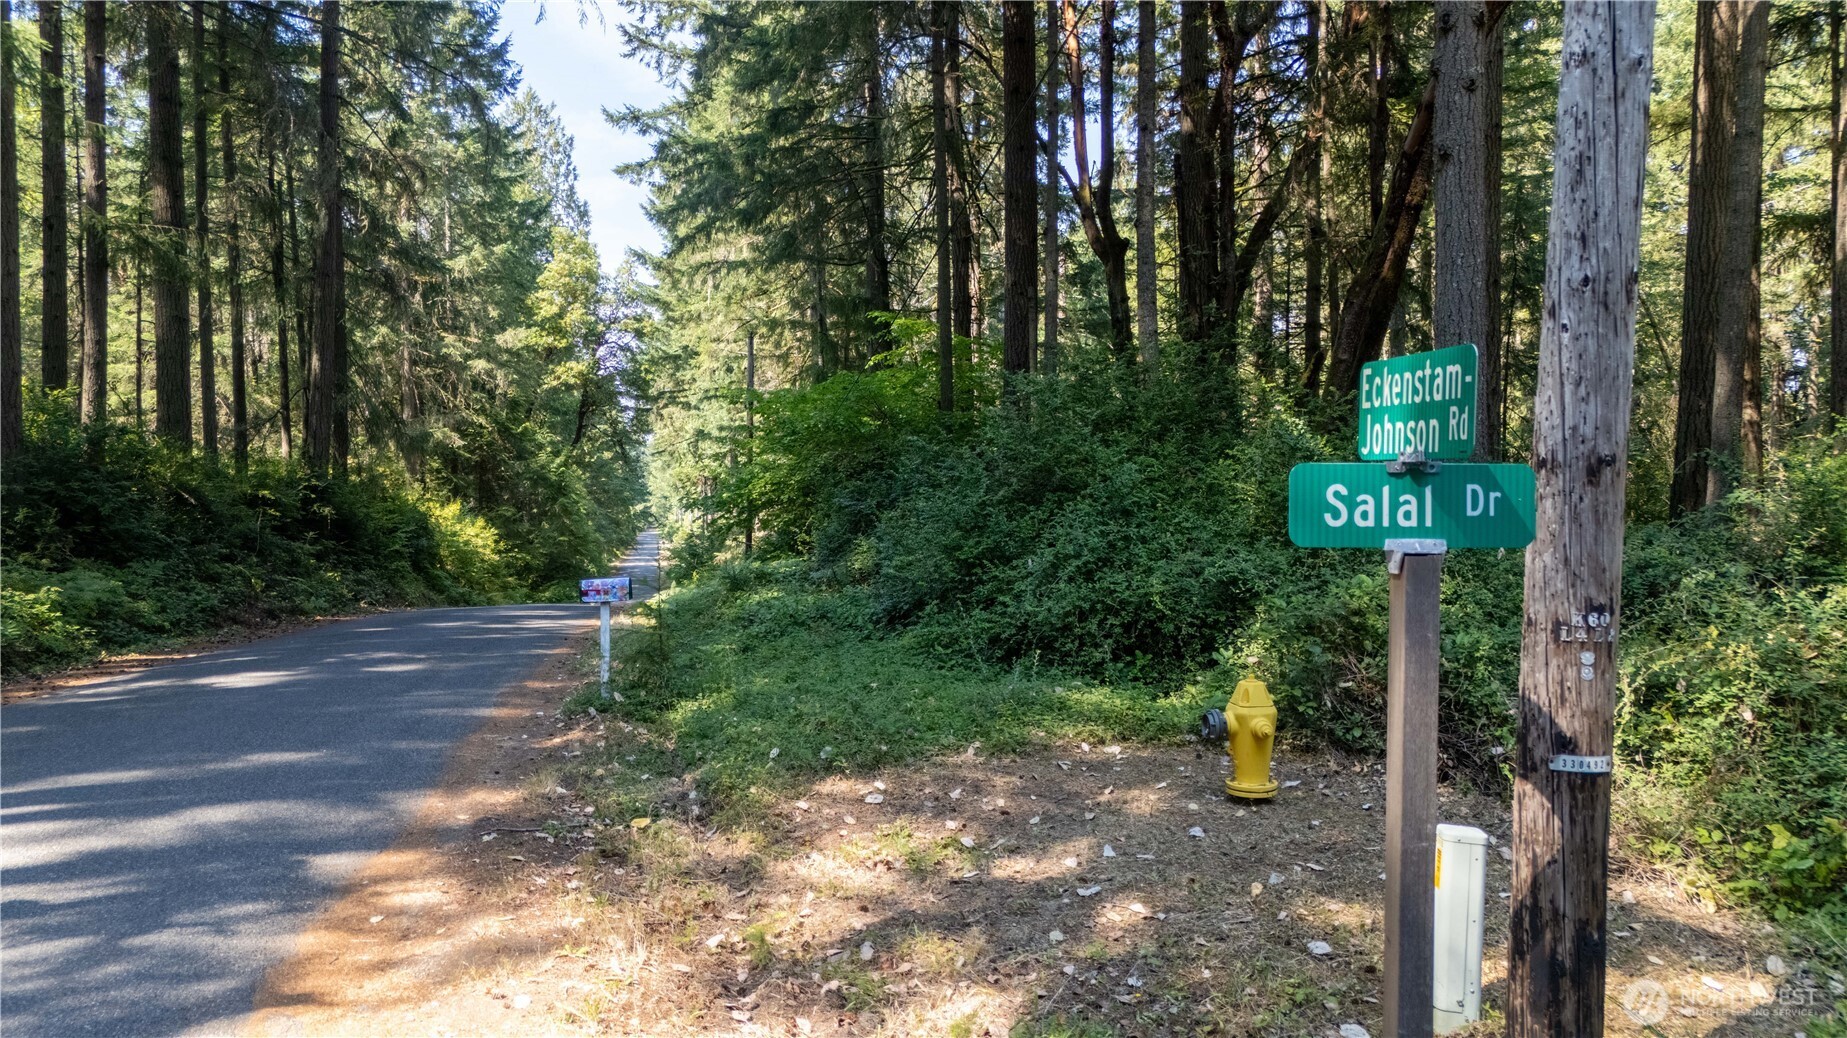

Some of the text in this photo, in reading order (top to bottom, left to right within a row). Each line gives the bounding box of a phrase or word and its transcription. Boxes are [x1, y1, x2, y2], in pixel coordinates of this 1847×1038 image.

[1361, 359, 1472, 409] Eckenstam-
[1361, 405, 1469, 455] Johnson Rd
[1323, 483, 1501, 528] Salal Dr
[1561, 758, 1604, 770] 330492
